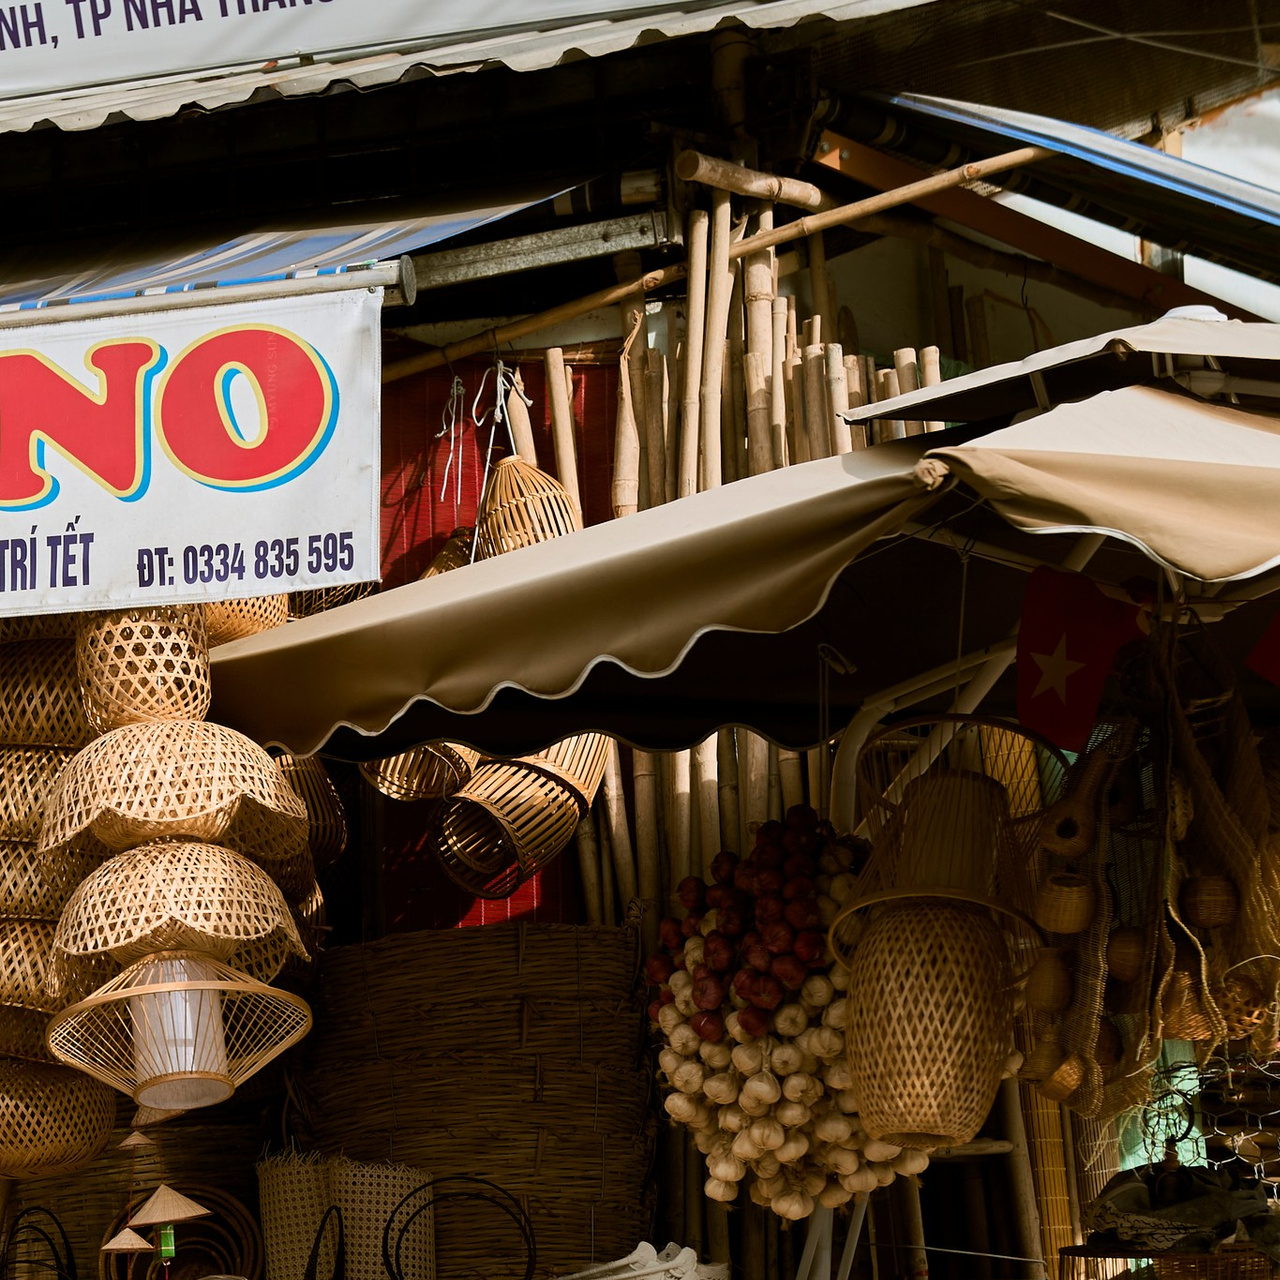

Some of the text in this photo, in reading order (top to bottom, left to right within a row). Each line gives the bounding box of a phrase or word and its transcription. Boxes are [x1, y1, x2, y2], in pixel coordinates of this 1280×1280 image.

[65, 0, 112, 39] TP
[46, 515, 95, 589] TẾT
[136, 547, 175, 588] ĐT:
[183, 542, 246, 585] 0334
[254, 537, 300, 580] 835
[308, 531, 355, 574] 595
